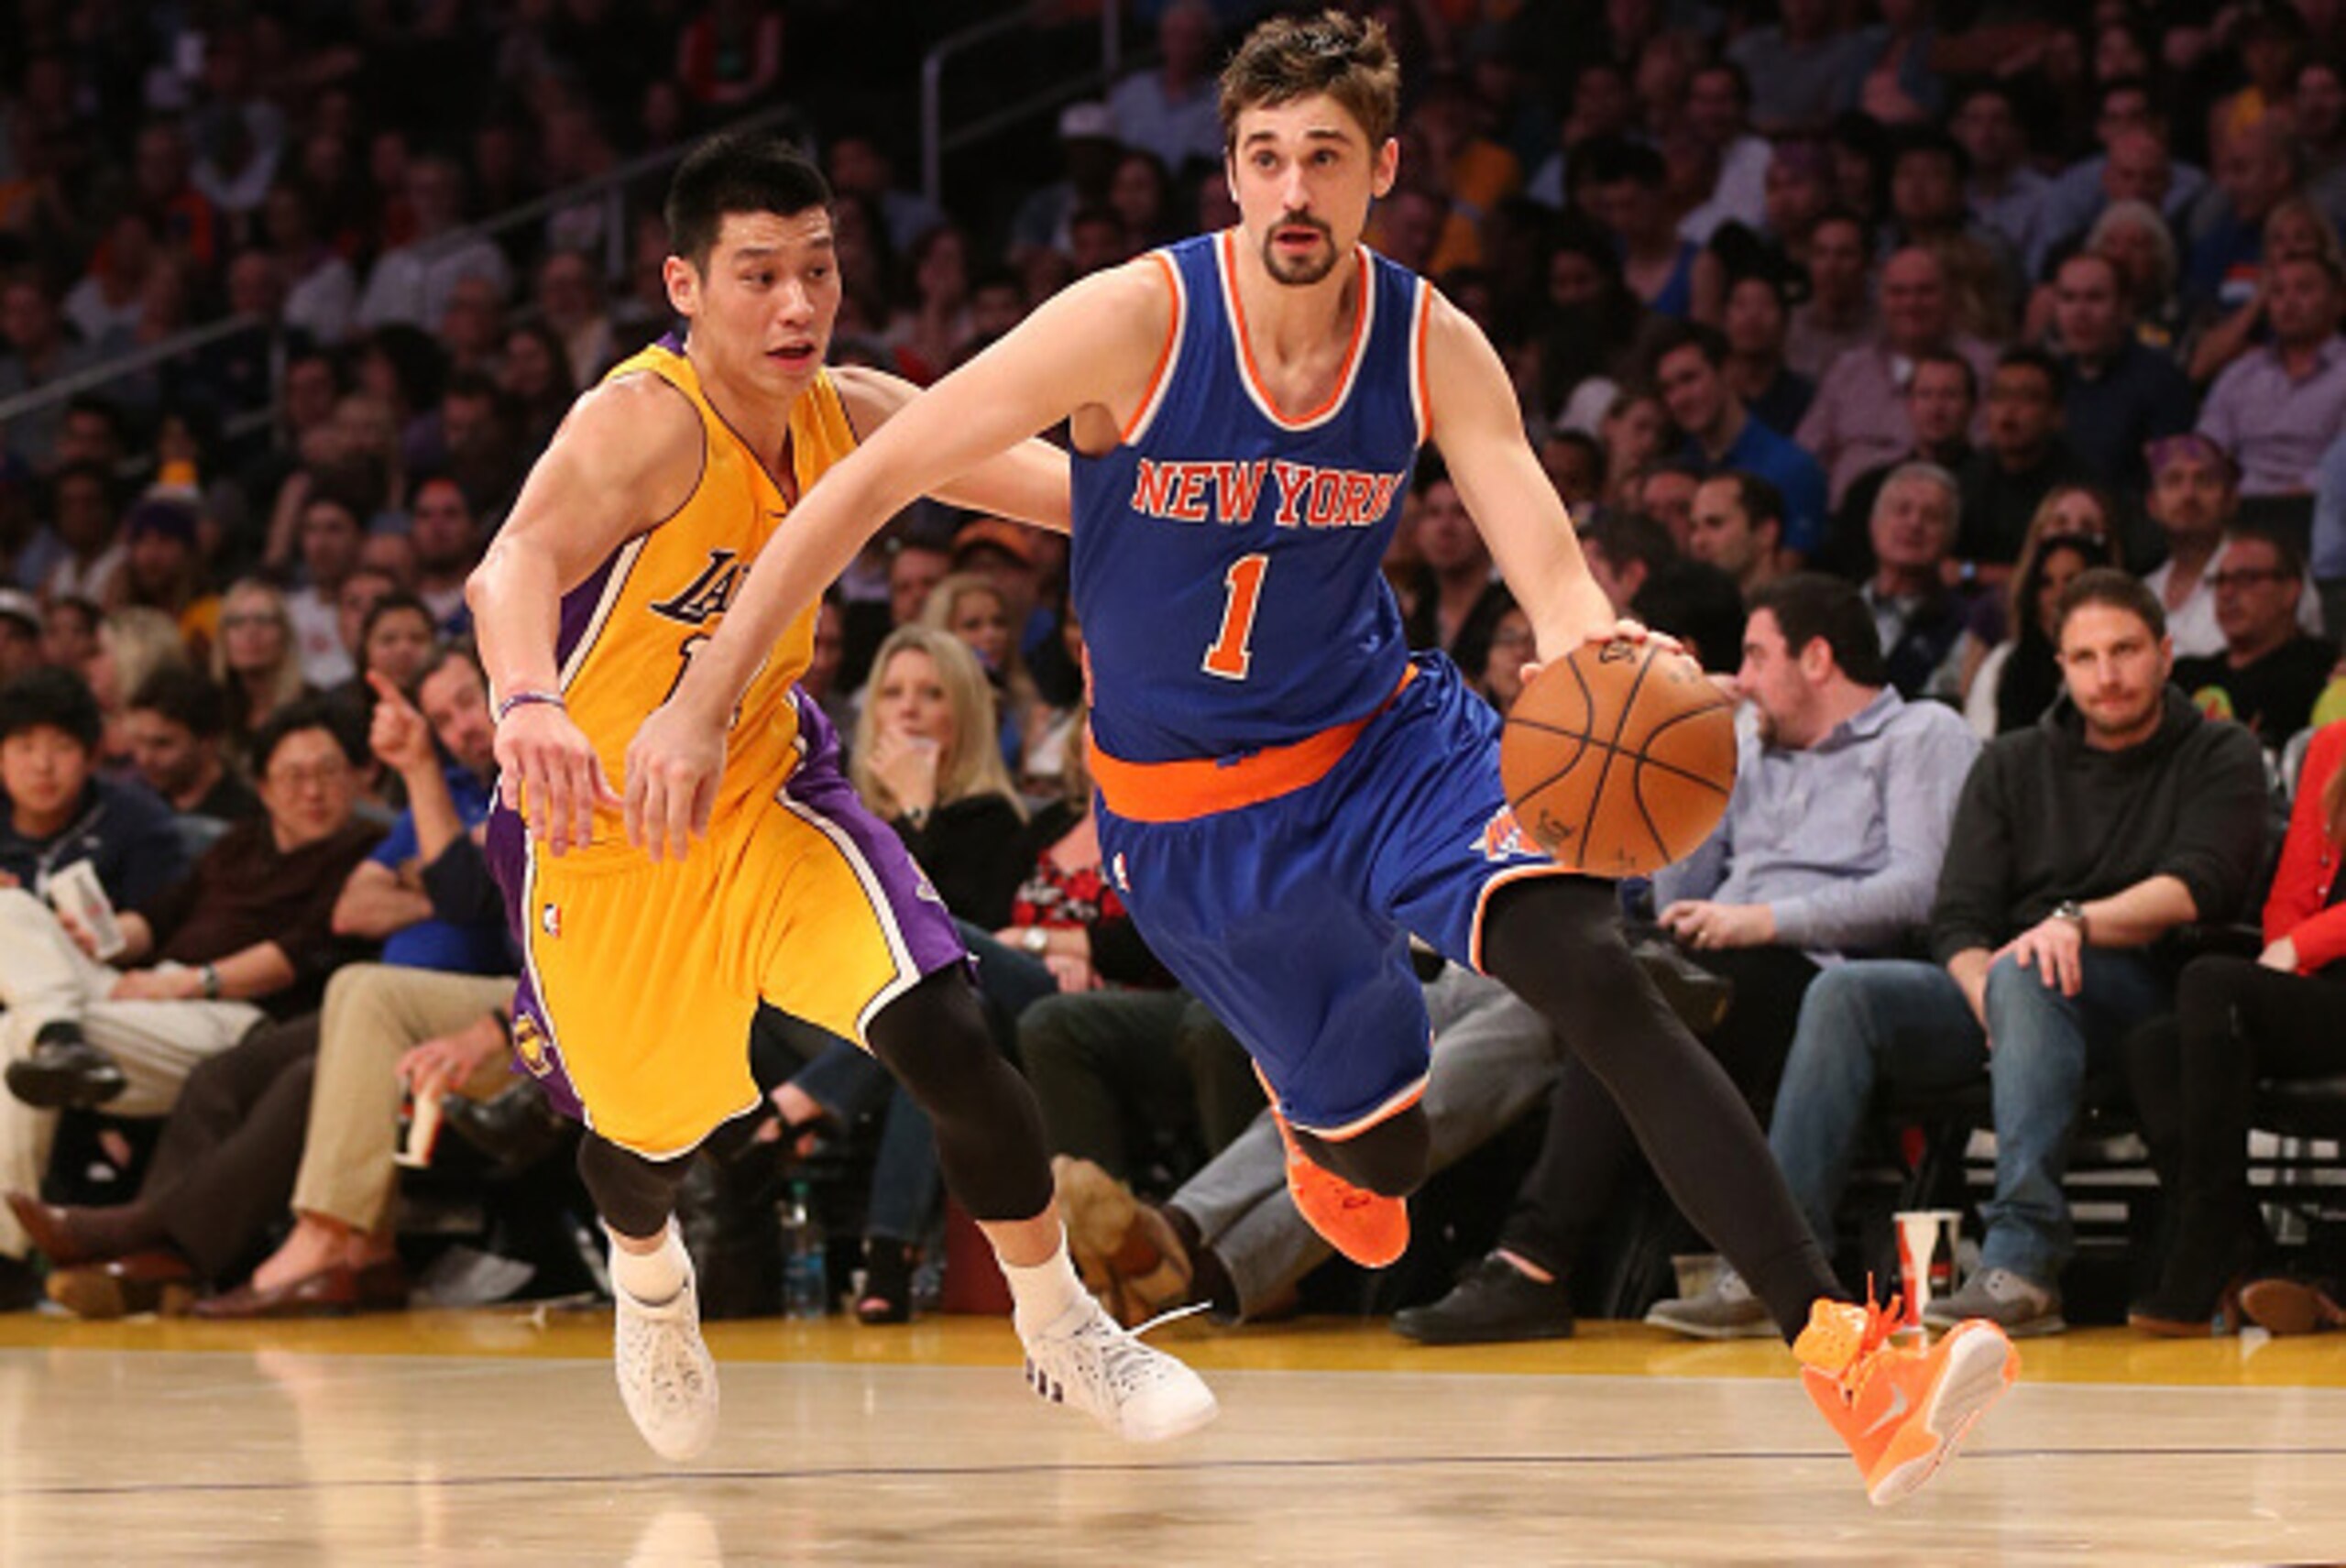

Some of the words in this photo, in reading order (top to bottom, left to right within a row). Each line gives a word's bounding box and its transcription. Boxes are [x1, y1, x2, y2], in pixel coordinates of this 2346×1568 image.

[1131, 457, 1267, 523] NEW
[1274, 460, 1407, 528] YORK
[1200, 553, 1270, 681] 1
